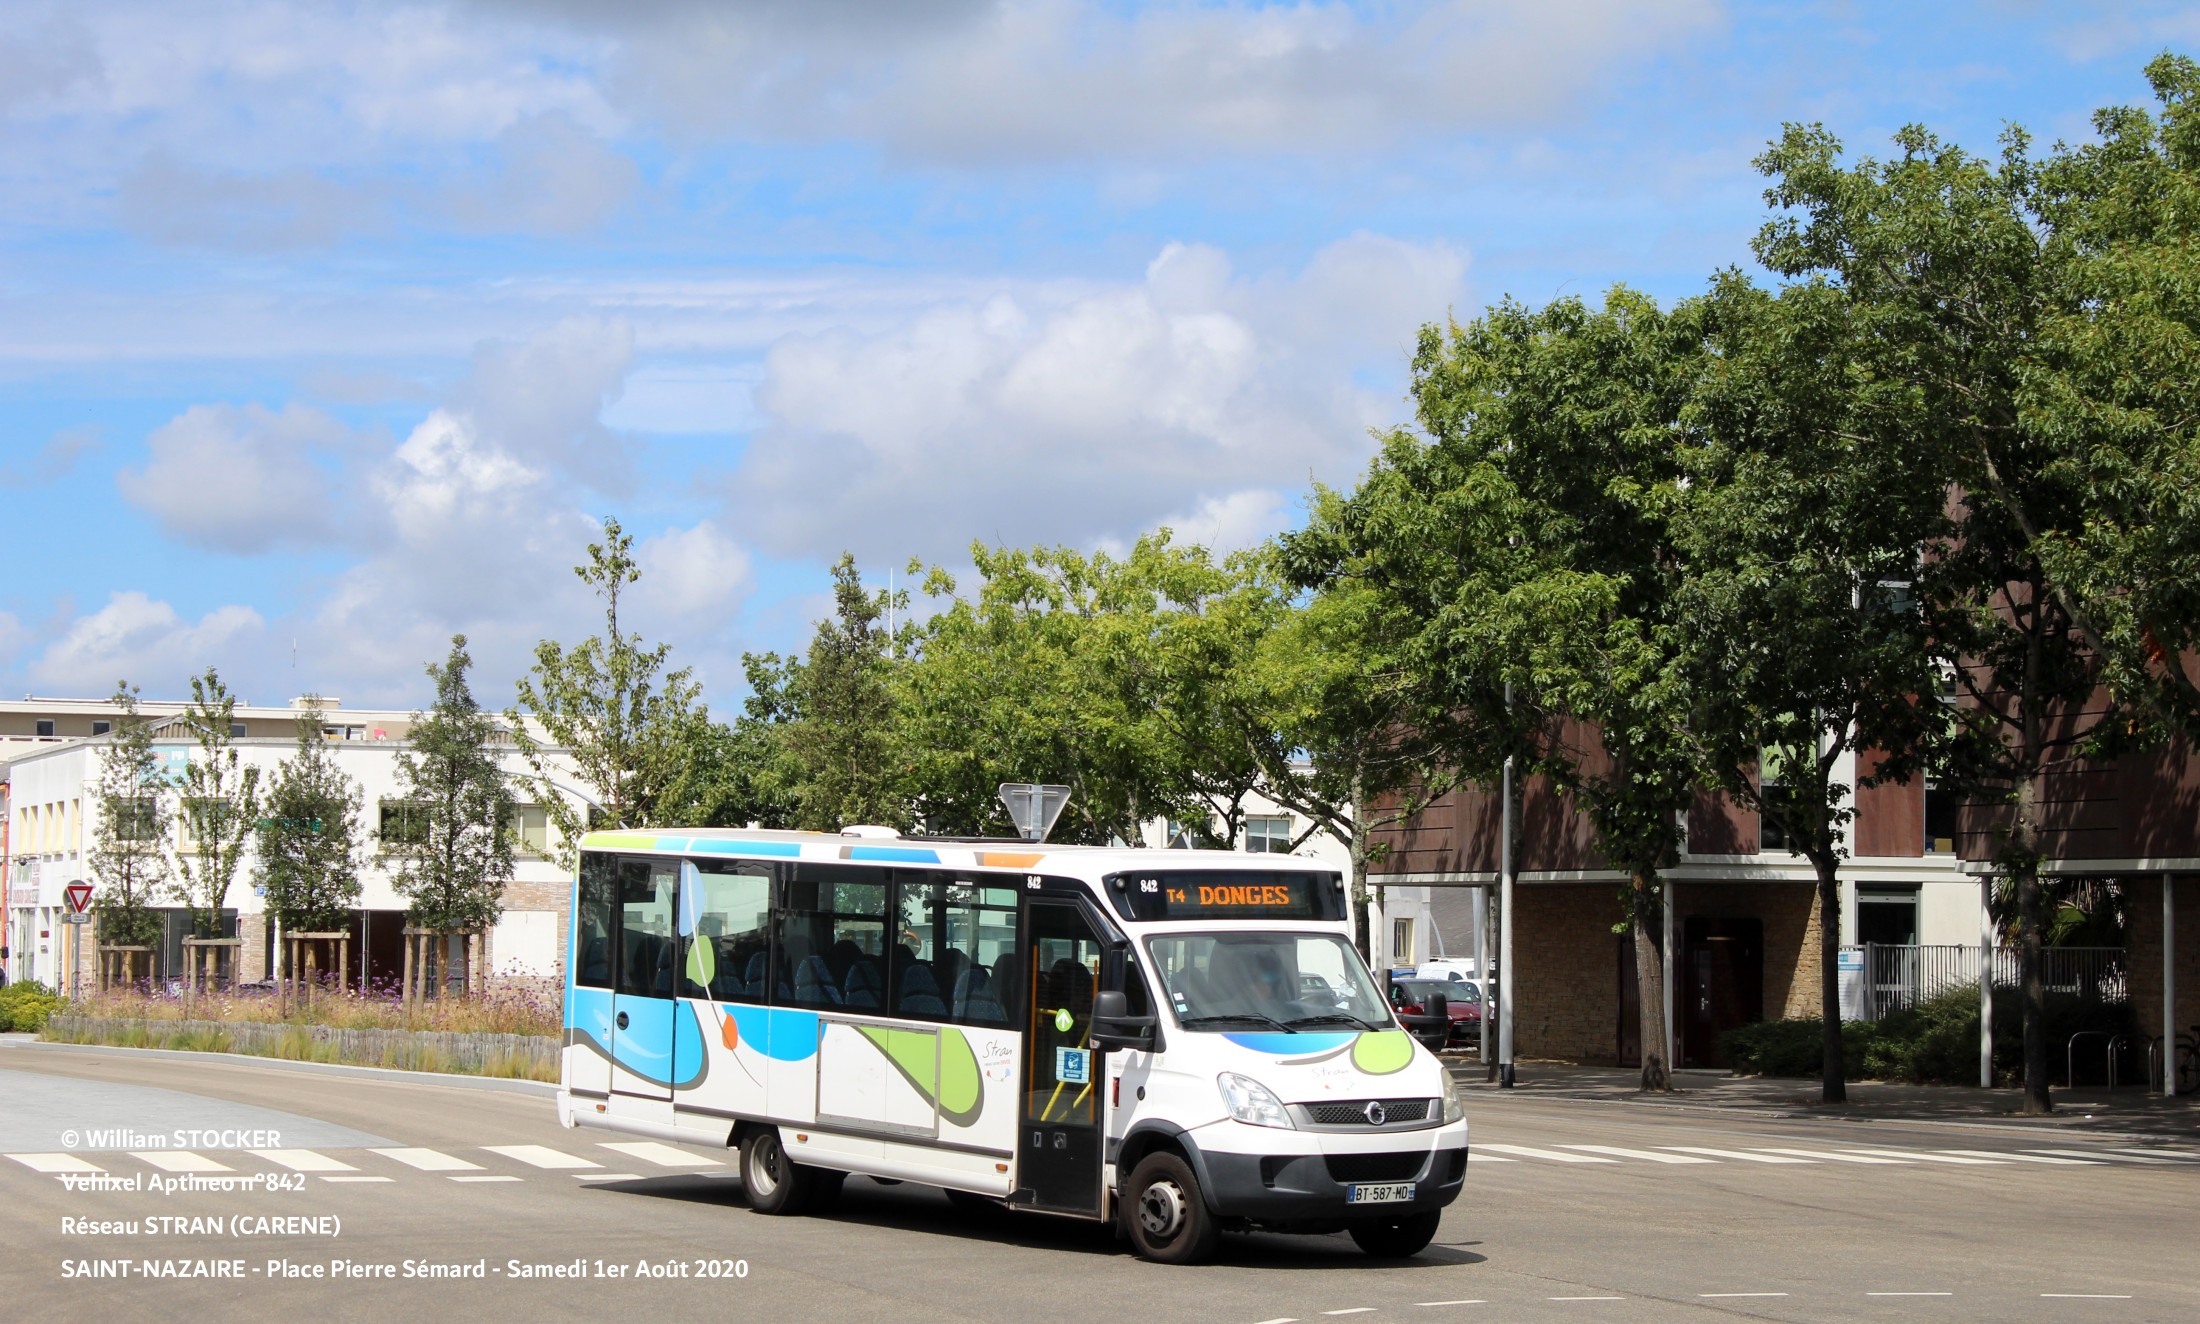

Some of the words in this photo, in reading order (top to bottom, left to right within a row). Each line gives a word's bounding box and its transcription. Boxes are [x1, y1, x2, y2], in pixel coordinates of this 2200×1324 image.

[1027, 876, 1041, 889] 842
[1140, 880, 1158, 892] 842
[1167, 889, 1185, 903] T4
[1198, 886, 1290, 905] DONGES
[982, 1040, 1013, 1058] Stran
[1356, 1186, 1408, 1201] BT-587-MD
